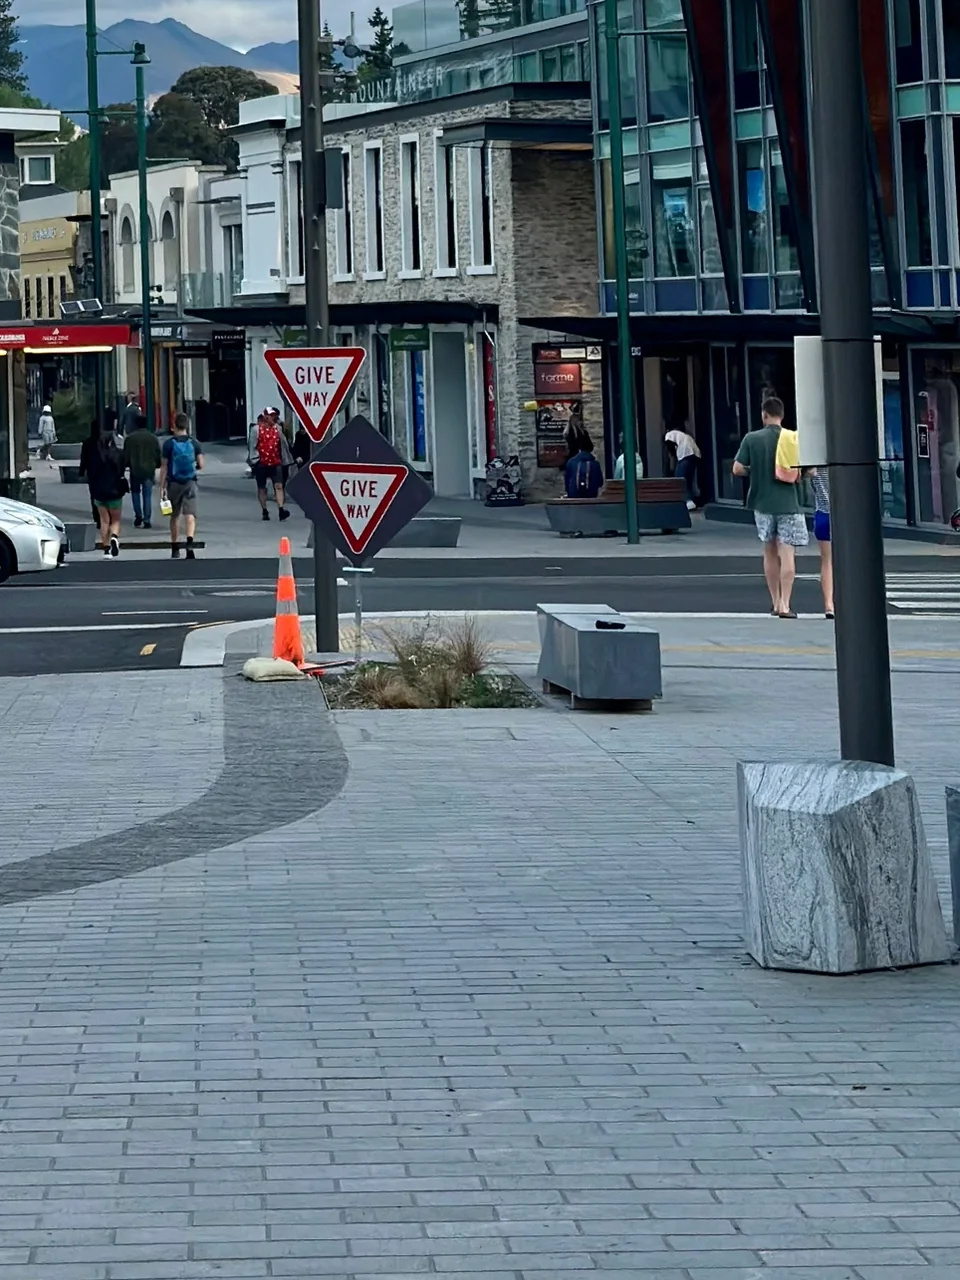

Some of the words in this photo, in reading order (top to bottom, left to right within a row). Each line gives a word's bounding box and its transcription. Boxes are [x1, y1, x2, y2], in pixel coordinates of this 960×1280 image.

[295, 366, 335, 384] GIVE
[541, 373, 574, 382] forme
[303, 392, 328, 407] WAY
[340, 479, 378, 497] GIVE
[347, 504, 370, 518] WAY
